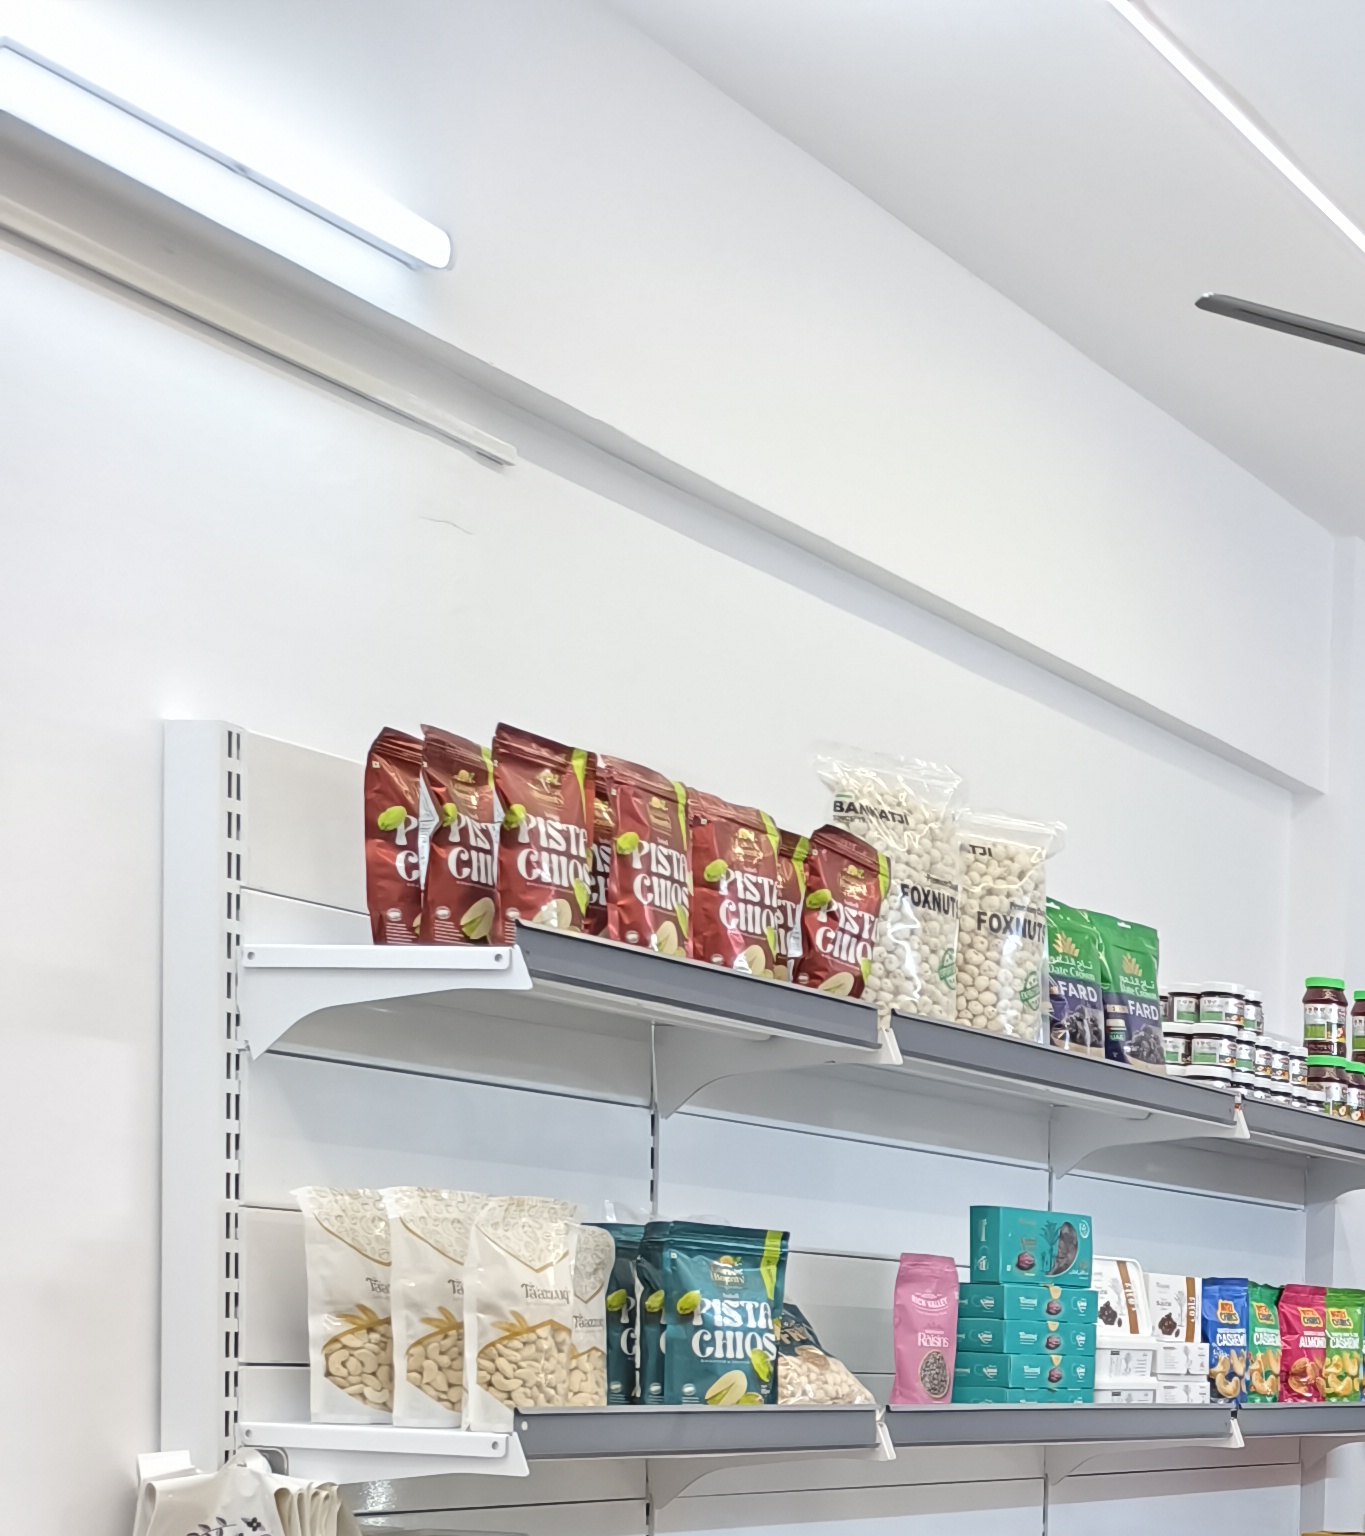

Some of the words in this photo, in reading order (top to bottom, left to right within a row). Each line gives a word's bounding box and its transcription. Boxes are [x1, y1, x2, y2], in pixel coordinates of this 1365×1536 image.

[1059, 981, 1098, 1003] FARD
[1127, 1000, 1159, 1021] FARD
[692, 1298, 773, 1329] PISTA
[691, 1329, 776, 1361] CHIOS
[918, 1332, 949, 1348] Raisins
